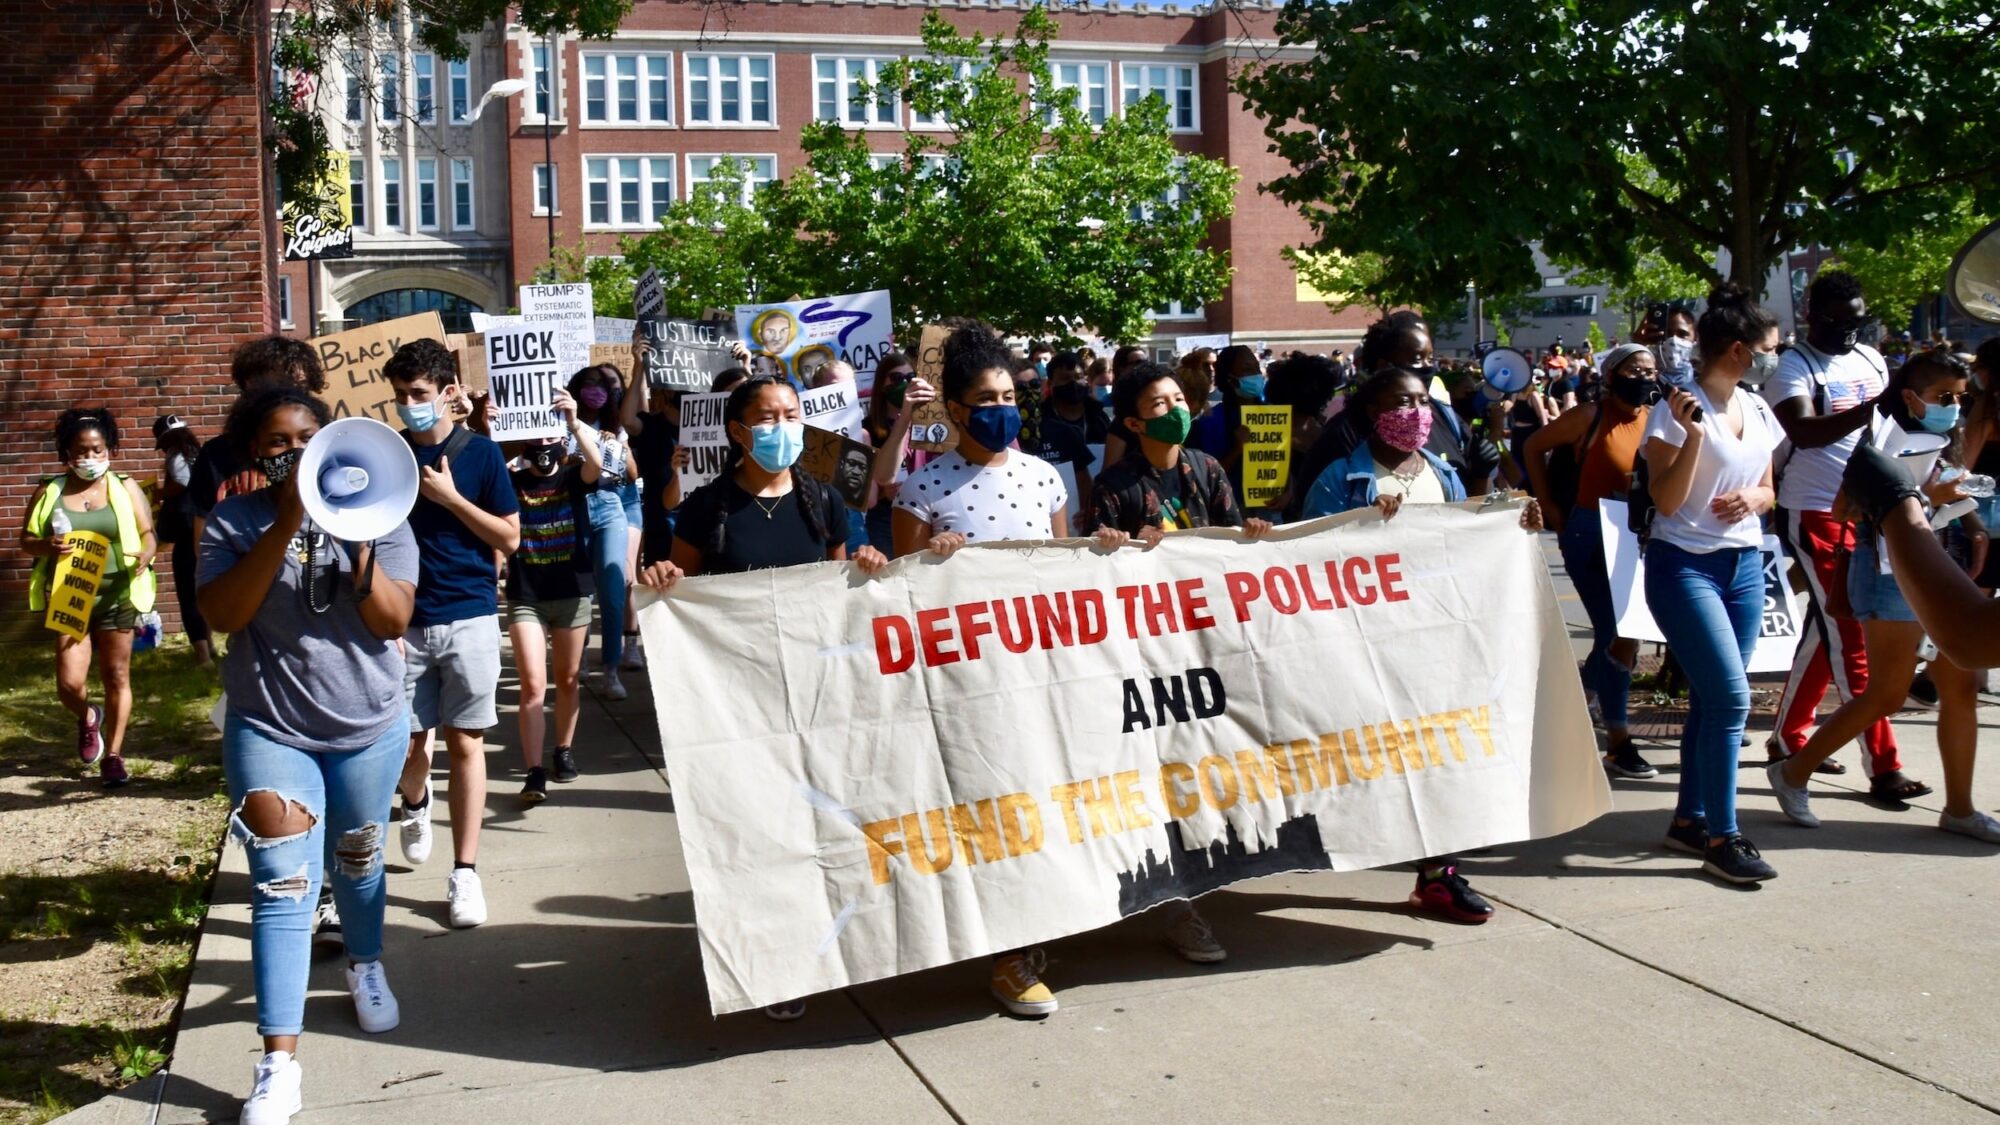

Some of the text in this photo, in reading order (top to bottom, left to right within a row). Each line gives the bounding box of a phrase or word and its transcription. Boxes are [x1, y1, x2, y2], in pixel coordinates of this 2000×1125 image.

[296, 215, 321, 238] Go
[286, 227, 352, 257] Knights!
[528, 284, 584, 298] TRUMP'S
[534, 301, 582, 311] SYSTEMATIC
[524, 312, 586, 322] EXTERMINATION
[644, 320, 717, 345] JUSTICE
[490, 330, 556, 365] FUCK
[595, 345, 630, 357] DEFU
[649, 347, 696, 368] RIAH
[649, 367, 713, 386] MILTON
[492, 371, 557, 408] WHITE
[803, 391, 846, 416] BLACK
[494, 409, 562, 431] SUPREMACY
[1245, 413, 1288, 425] PROTECT
[702, 431, 718, 441] POLICE
[1250, 431, 1283, 443] BLACK
[263, 453, 295, 469] BLACK
[1248, 450, 1285, 462] WOMEN
[1256, 469, 1277, 480] AND
[71, 556, 99, 576] BLACK
[64, 574, 95, 595] WOMEN
[68, 595, 85, 612] AND
[872, 553, 1410, 675] DEFUND THE POLICE
[1122, 667, 1227, 733] AND
[863, 705, 1496, 886] FUND THE COMMUNITY
